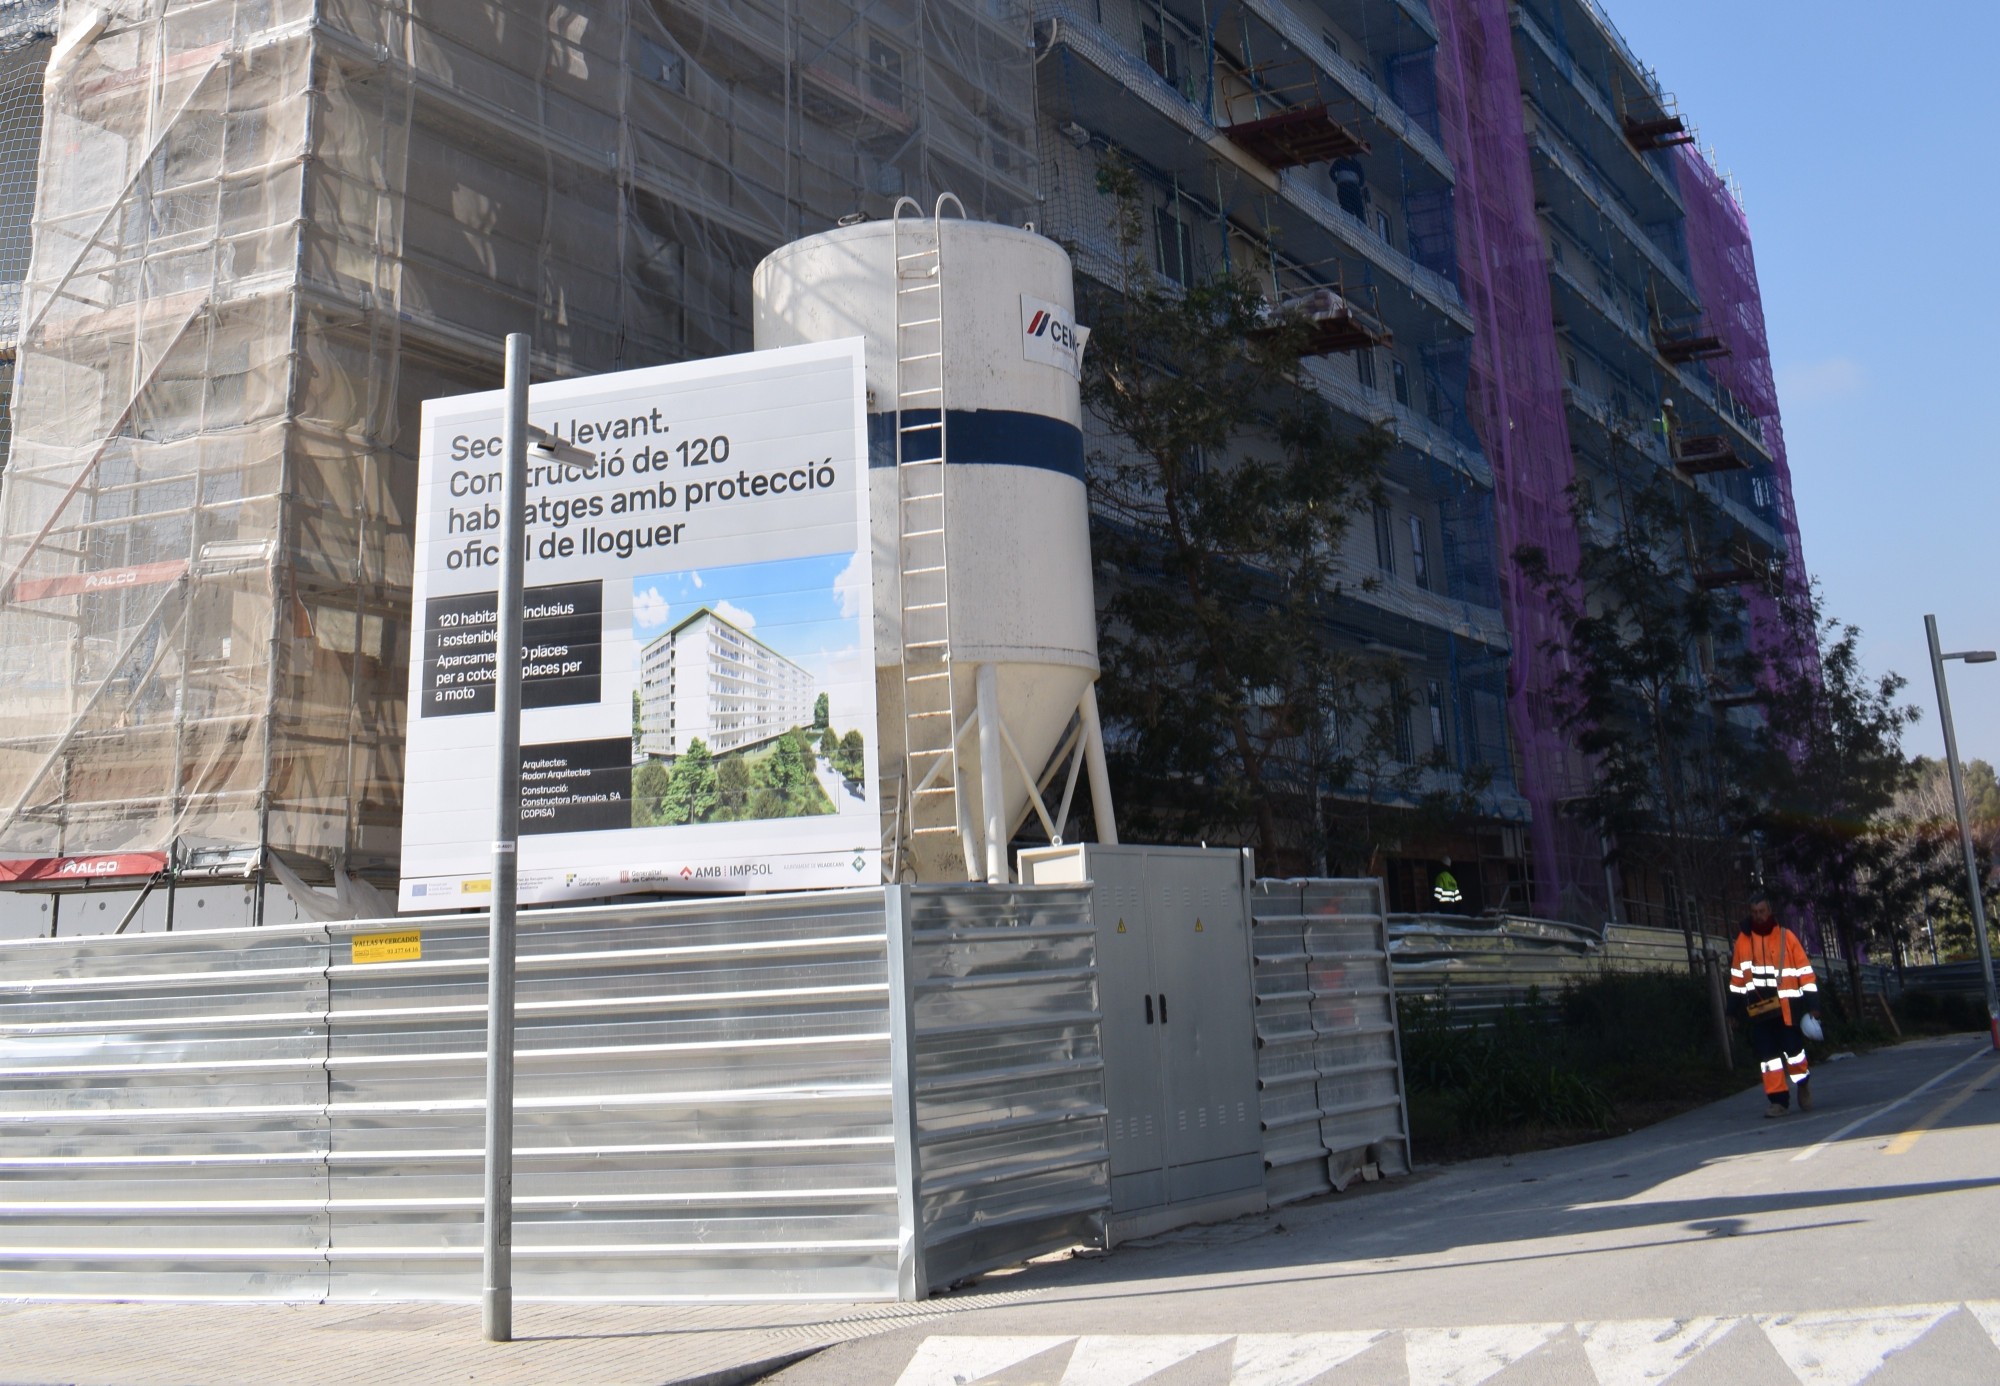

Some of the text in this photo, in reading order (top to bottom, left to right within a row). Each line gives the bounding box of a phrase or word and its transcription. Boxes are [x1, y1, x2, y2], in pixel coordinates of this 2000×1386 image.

[1051, 321, 1080, 352] CEM
[451, 434, 503, 461] Sec
[450, 435, 730, 497] Contrucció de 120
[448, 457, 835, 534] habatges amb protecció
[446, 523, 686, 570] oficl de lloguer
[438, 602, 575, 627] 120 habita inclusius
[437, 629, 498, 647] i sostenible
[436, 651, 498, 669] Aparcame
[530, 644, 568, 661] places
[436, 671, 456, 687] per
[457, 672, 464, 682] a
[522, 660, 560, 679] places
[562, 659, 582, 676] per
[435, 686, 476, 701] a moto
[522, 758, 568, 770] Arquitectes:
[522, 768, 591, 781] Rodon Arquitectes
[521, 783, 569, 796] Construcció:
[521, 796, 570, 808] Constructora
[609, 791, 621, 801] SA
[521, 807, 555, 820] (COPISA)
[76, 861, 118, 874] ALCO
[695, 863, 773, 878] AMB IMPSOL
[384, 936, 419, 945] CERCADOS
